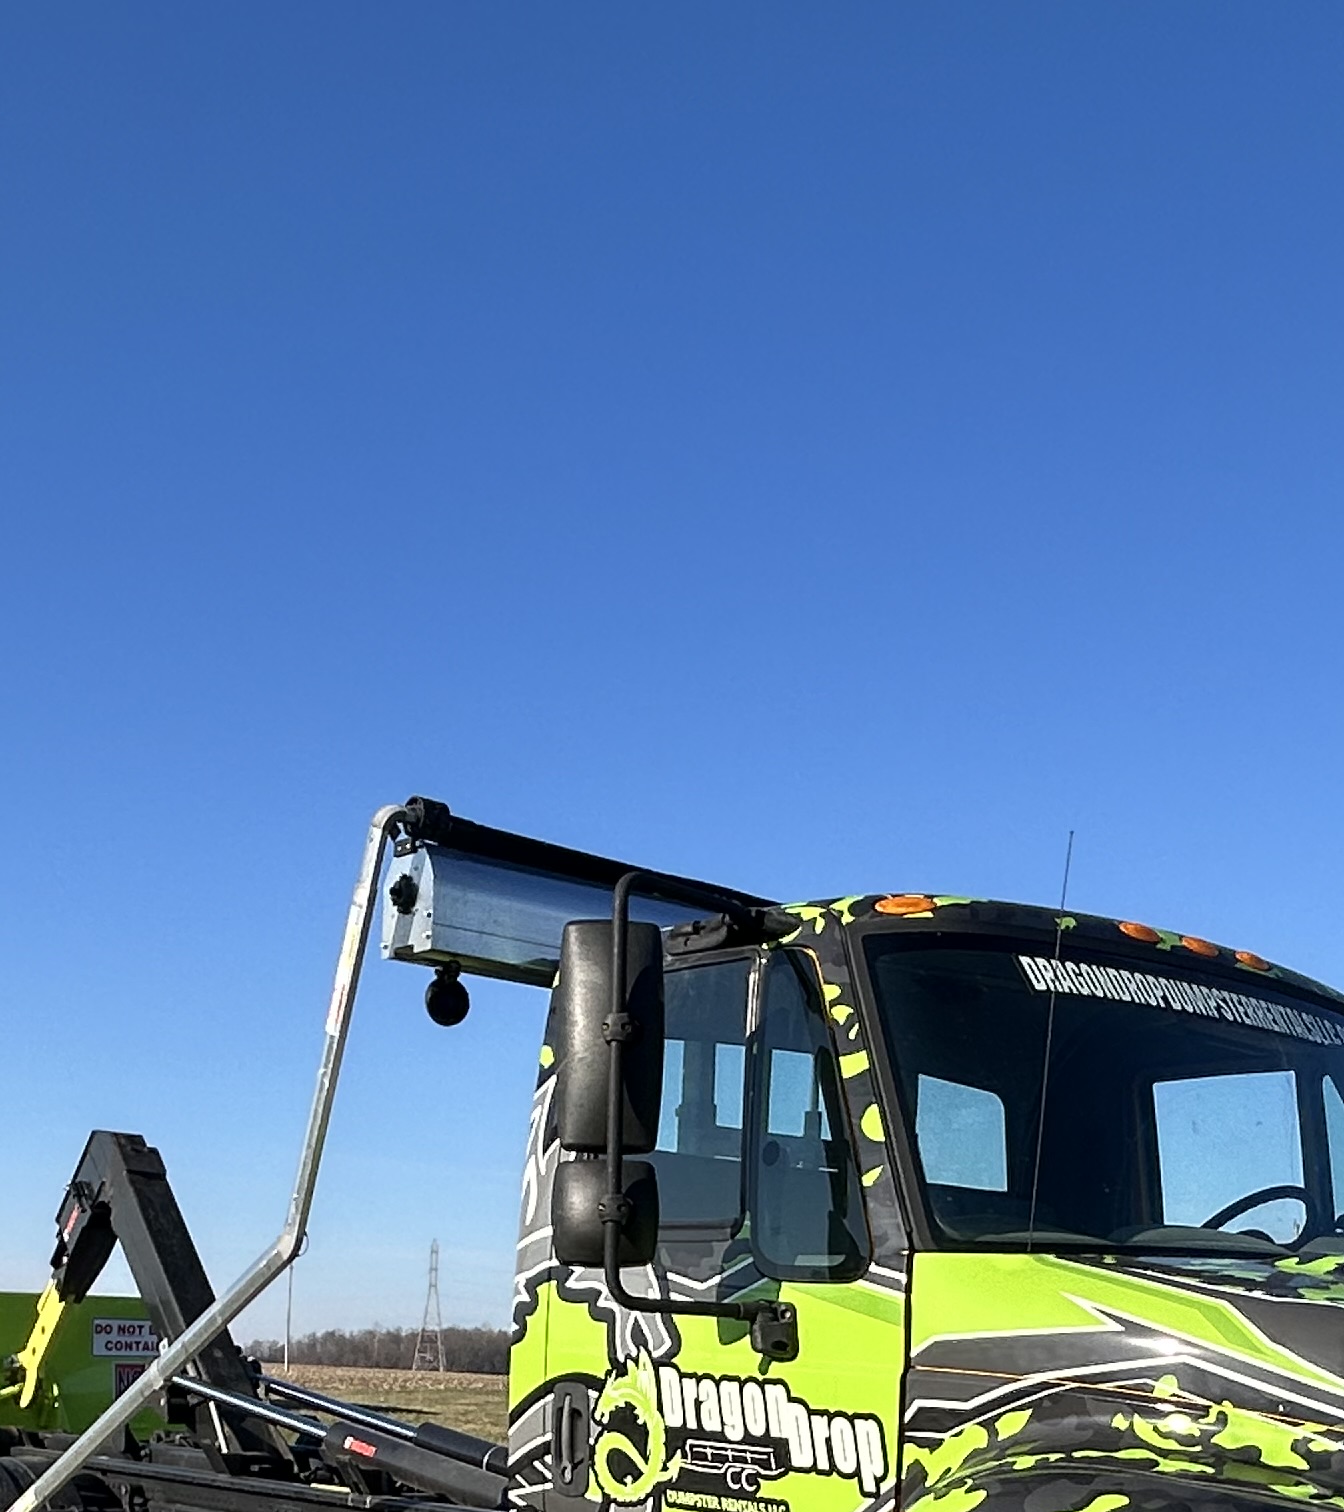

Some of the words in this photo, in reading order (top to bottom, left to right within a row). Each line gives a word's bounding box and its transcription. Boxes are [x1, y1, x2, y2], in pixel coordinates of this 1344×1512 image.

[95, 1324, 113, 1335] DO
[117, 1324, 145, 1336] NOT
[104, 1340, 157, 1352] CONTAI
[666, 1488, 721, 1509] DUMPSTER
